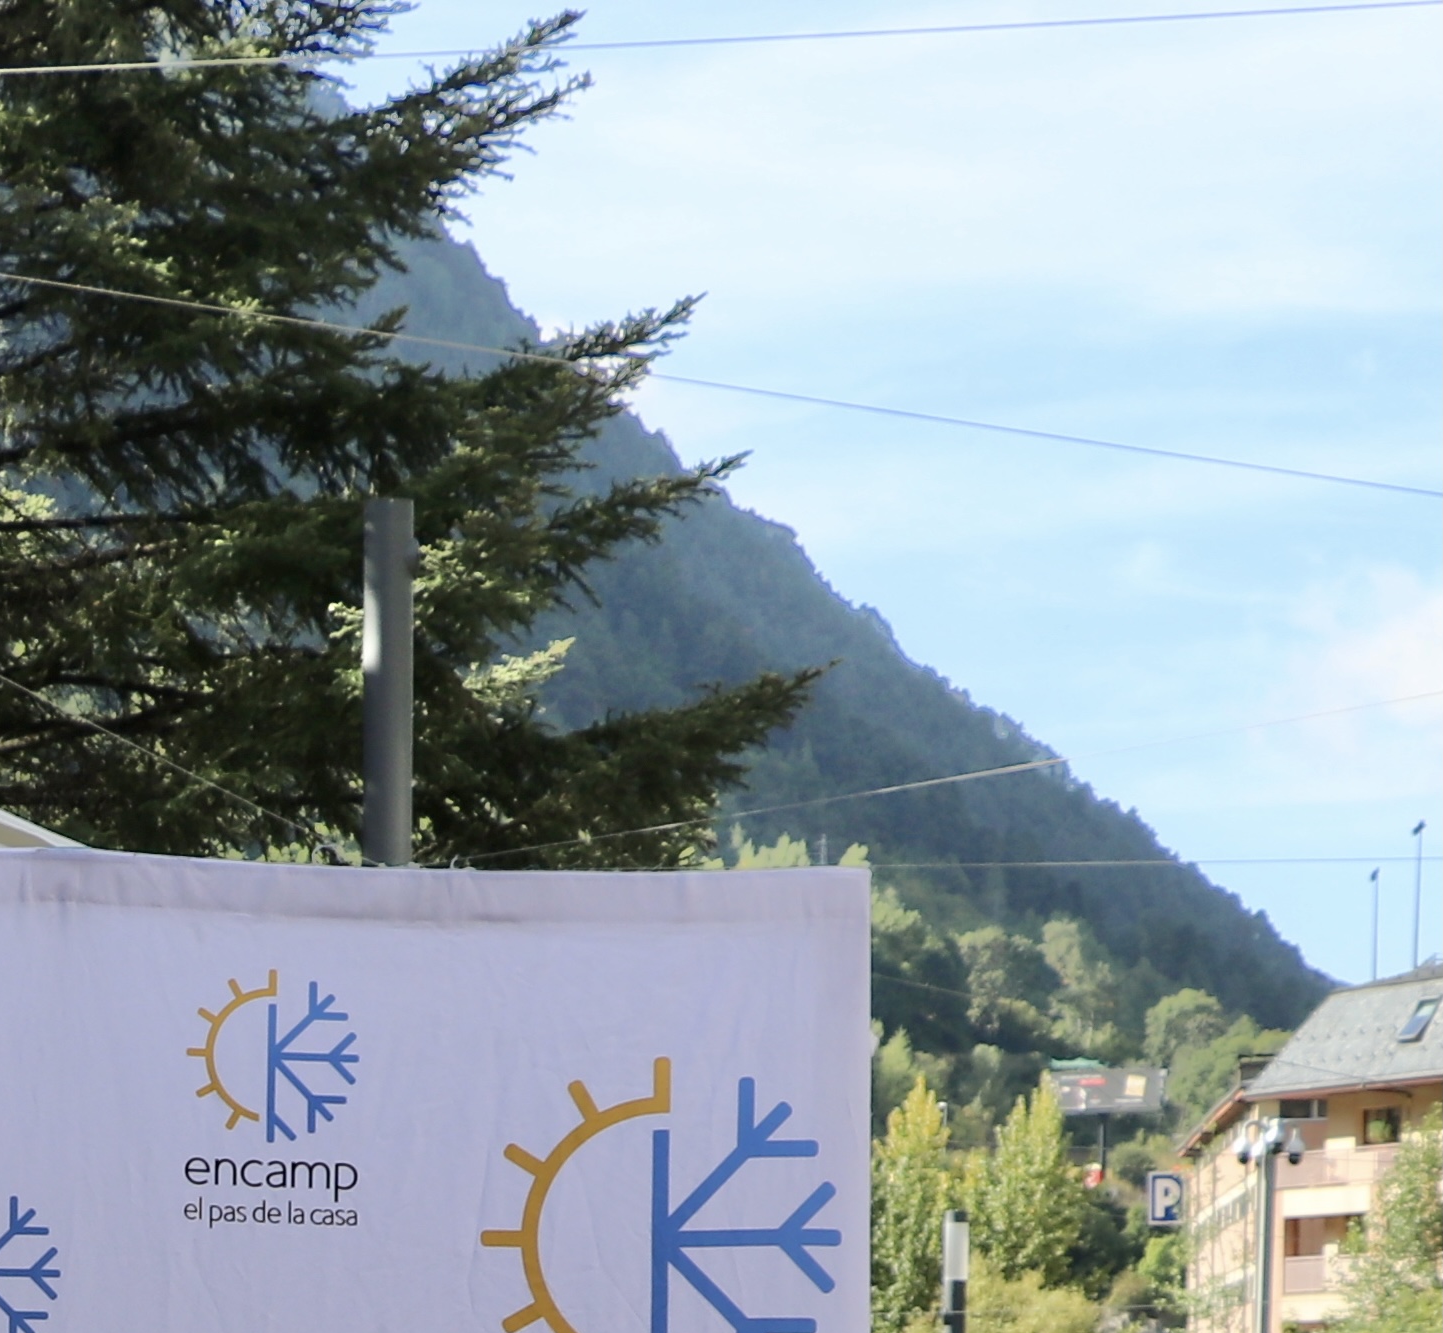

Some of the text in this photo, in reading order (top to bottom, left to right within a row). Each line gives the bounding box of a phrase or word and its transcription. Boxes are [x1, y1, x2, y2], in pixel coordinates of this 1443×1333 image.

[184, 1156, 359, 1203] encamp
[183, 1196, 358, 1229] el pas de la casa
